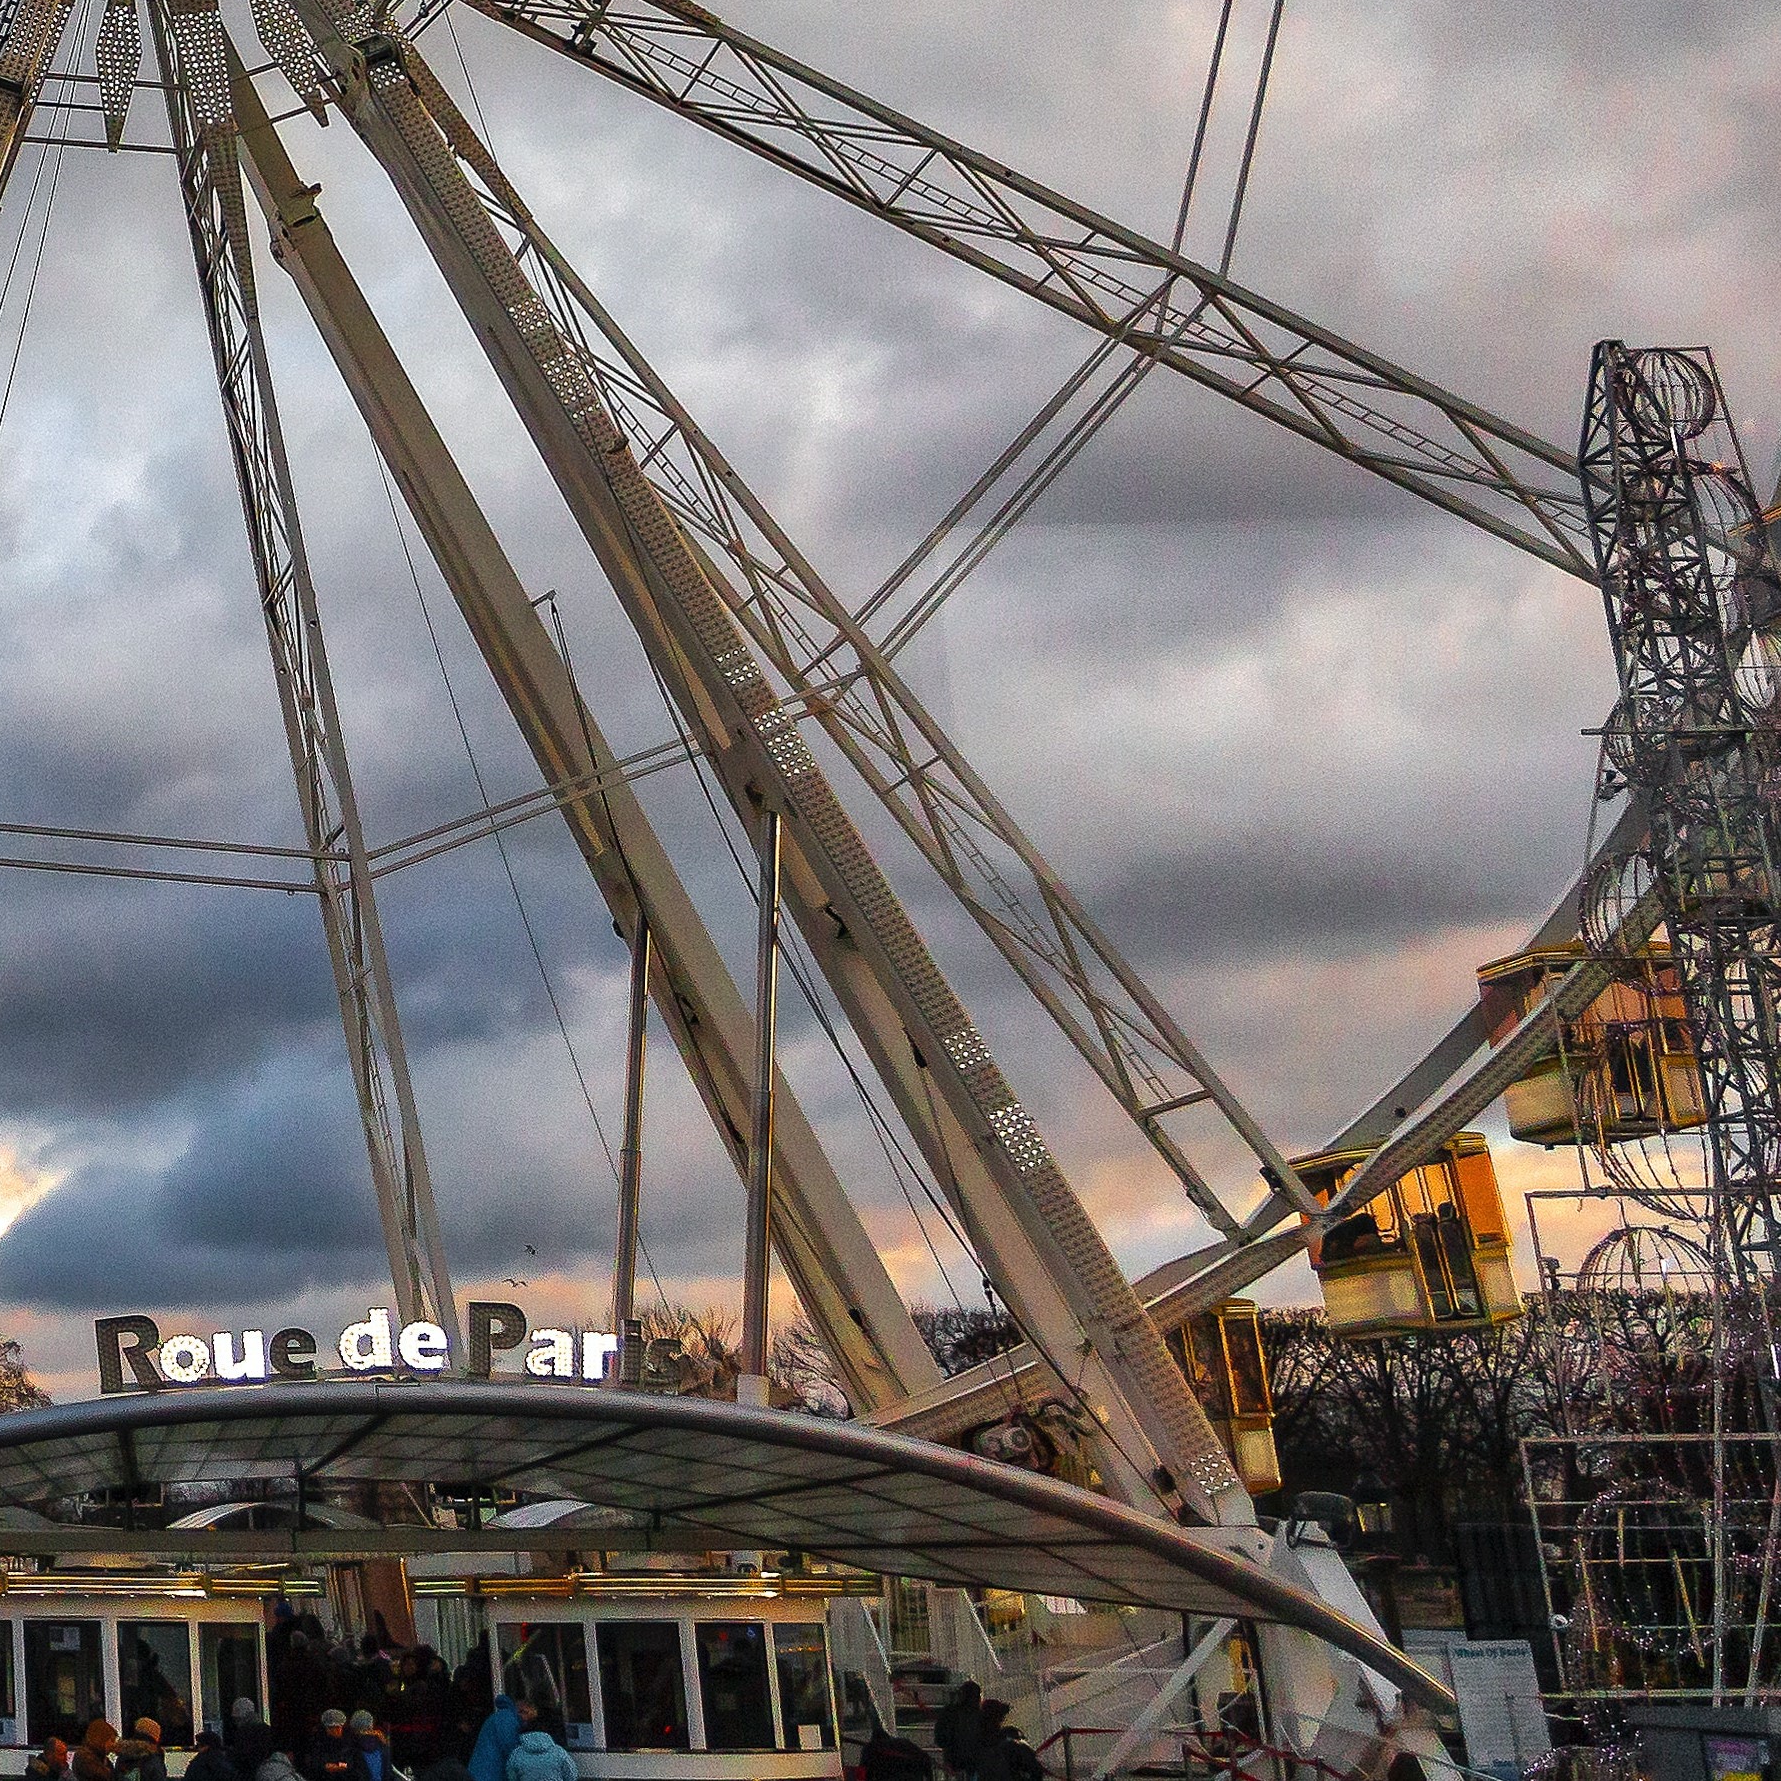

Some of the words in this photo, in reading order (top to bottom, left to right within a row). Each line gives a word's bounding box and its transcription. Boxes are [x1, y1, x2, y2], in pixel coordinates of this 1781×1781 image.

[95, 1314, 317, 1394] Roue
[339, 1307, 450, 1373] de
[469, 1300, 682, 1387] Paris
